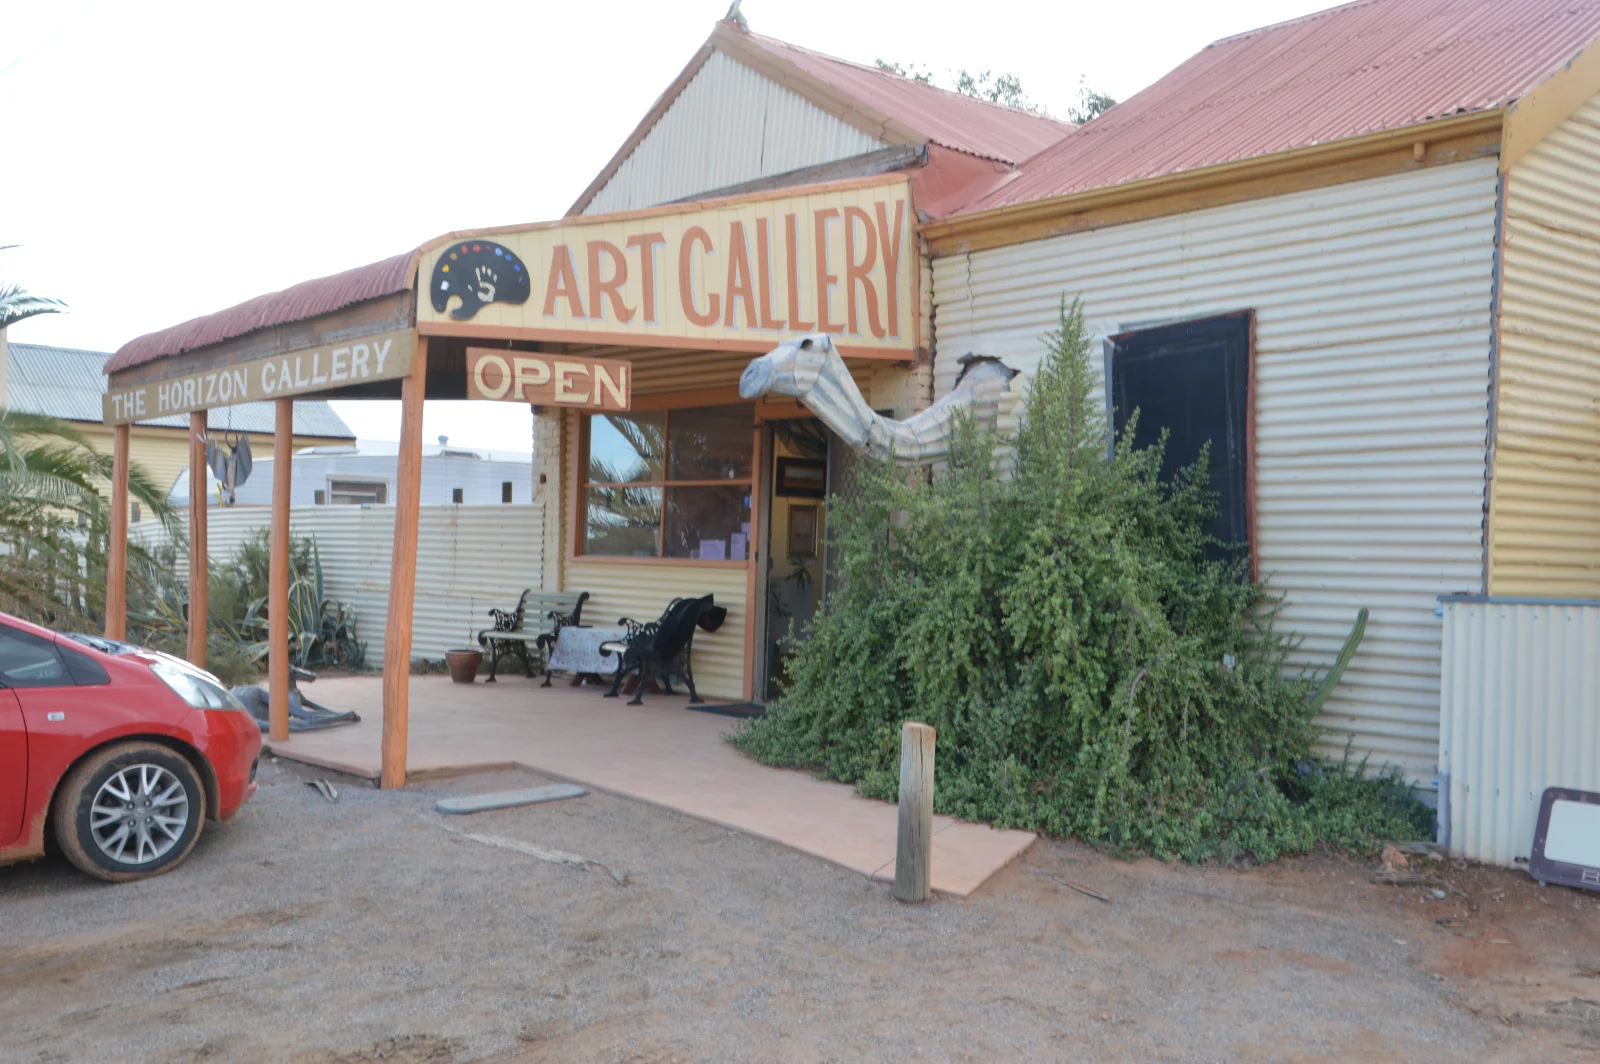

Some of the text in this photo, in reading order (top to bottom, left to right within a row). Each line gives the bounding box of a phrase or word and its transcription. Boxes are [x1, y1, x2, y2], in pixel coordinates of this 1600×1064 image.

[542, 199, 905, 341] ART GALLERY
[111, 389, 147, 421] THE
[158, 367, 248, 412] HORIZON
[473, 354, 629, 411] OPEN
